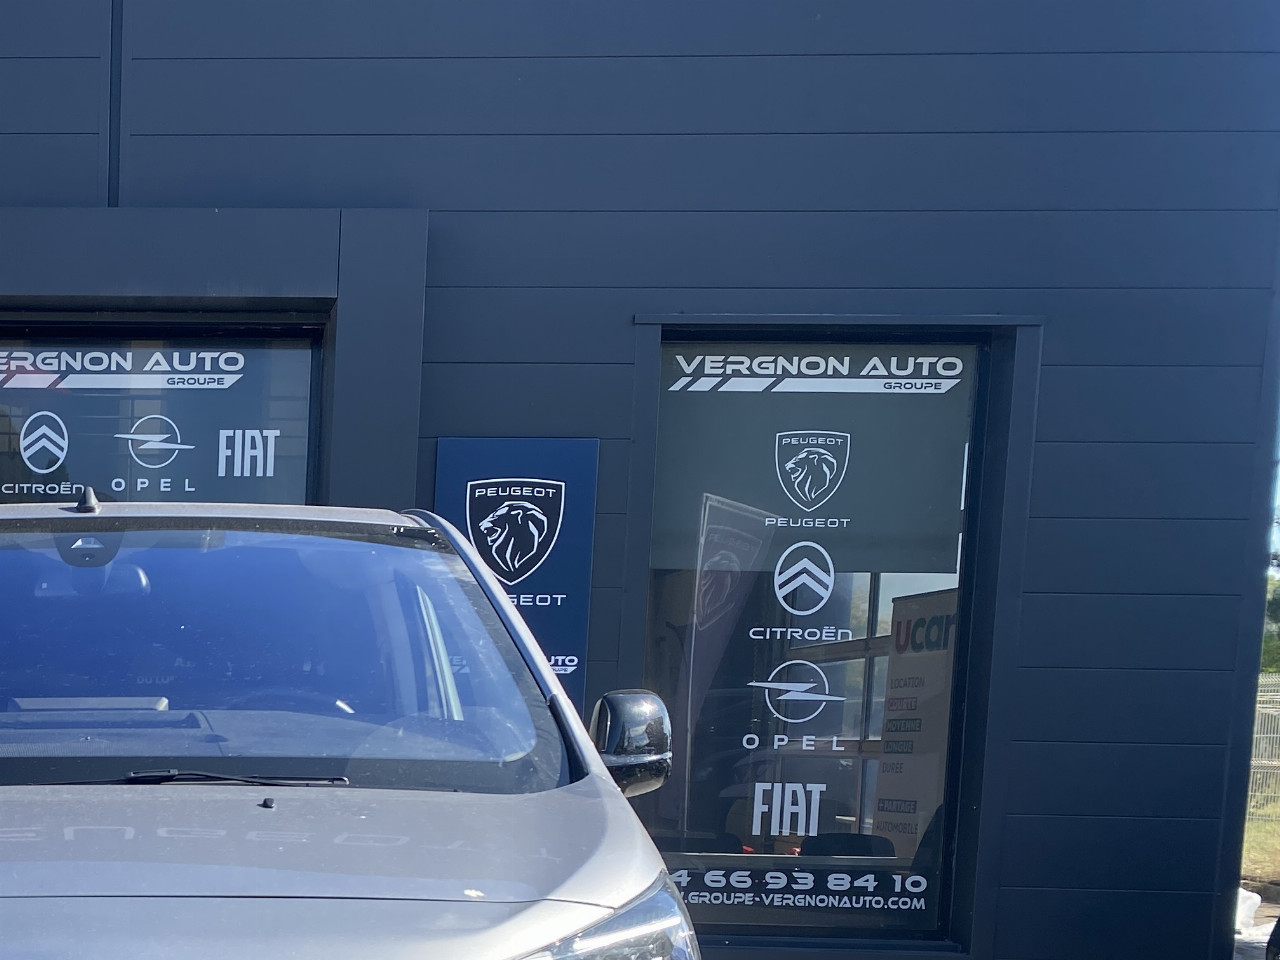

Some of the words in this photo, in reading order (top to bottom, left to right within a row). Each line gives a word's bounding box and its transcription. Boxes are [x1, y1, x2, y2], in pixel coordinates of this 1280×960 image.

[142, 351, 245, 372] AUTO
[675, 355, 850, 375] VERGNON
[859, 356, 963, 376] AUTO
[166, 377, 225, 386] GROUPE
[883, 381, 942, 390] GROUPE
[782, 436, 844, 446] PEUGEOT
[218, 429, 280, 477] FIAT
[111, 478, 196, 491] OPEL
[475, 486, 556, 498] PEUGEOT
[765, 517, 851, 528] PEUGEOT
[890, 676, 925, 690] LOCATION
[888, 699, 916, 711] COURTE
[886, 719, 921, 732] MOYENNE
[742, 734, 845, 750] OPEL
[884, 741, 913, 753] LONGUE
[751, 782, 827, 836] FIAT
[875, 821, 918, 835] AUTOMOBILE
[703, 870, 753, 888] 66
[765, 871, 814, 890] 93
[827, 873, 878, 892] 84
[892, 874, 928, 893] 10
